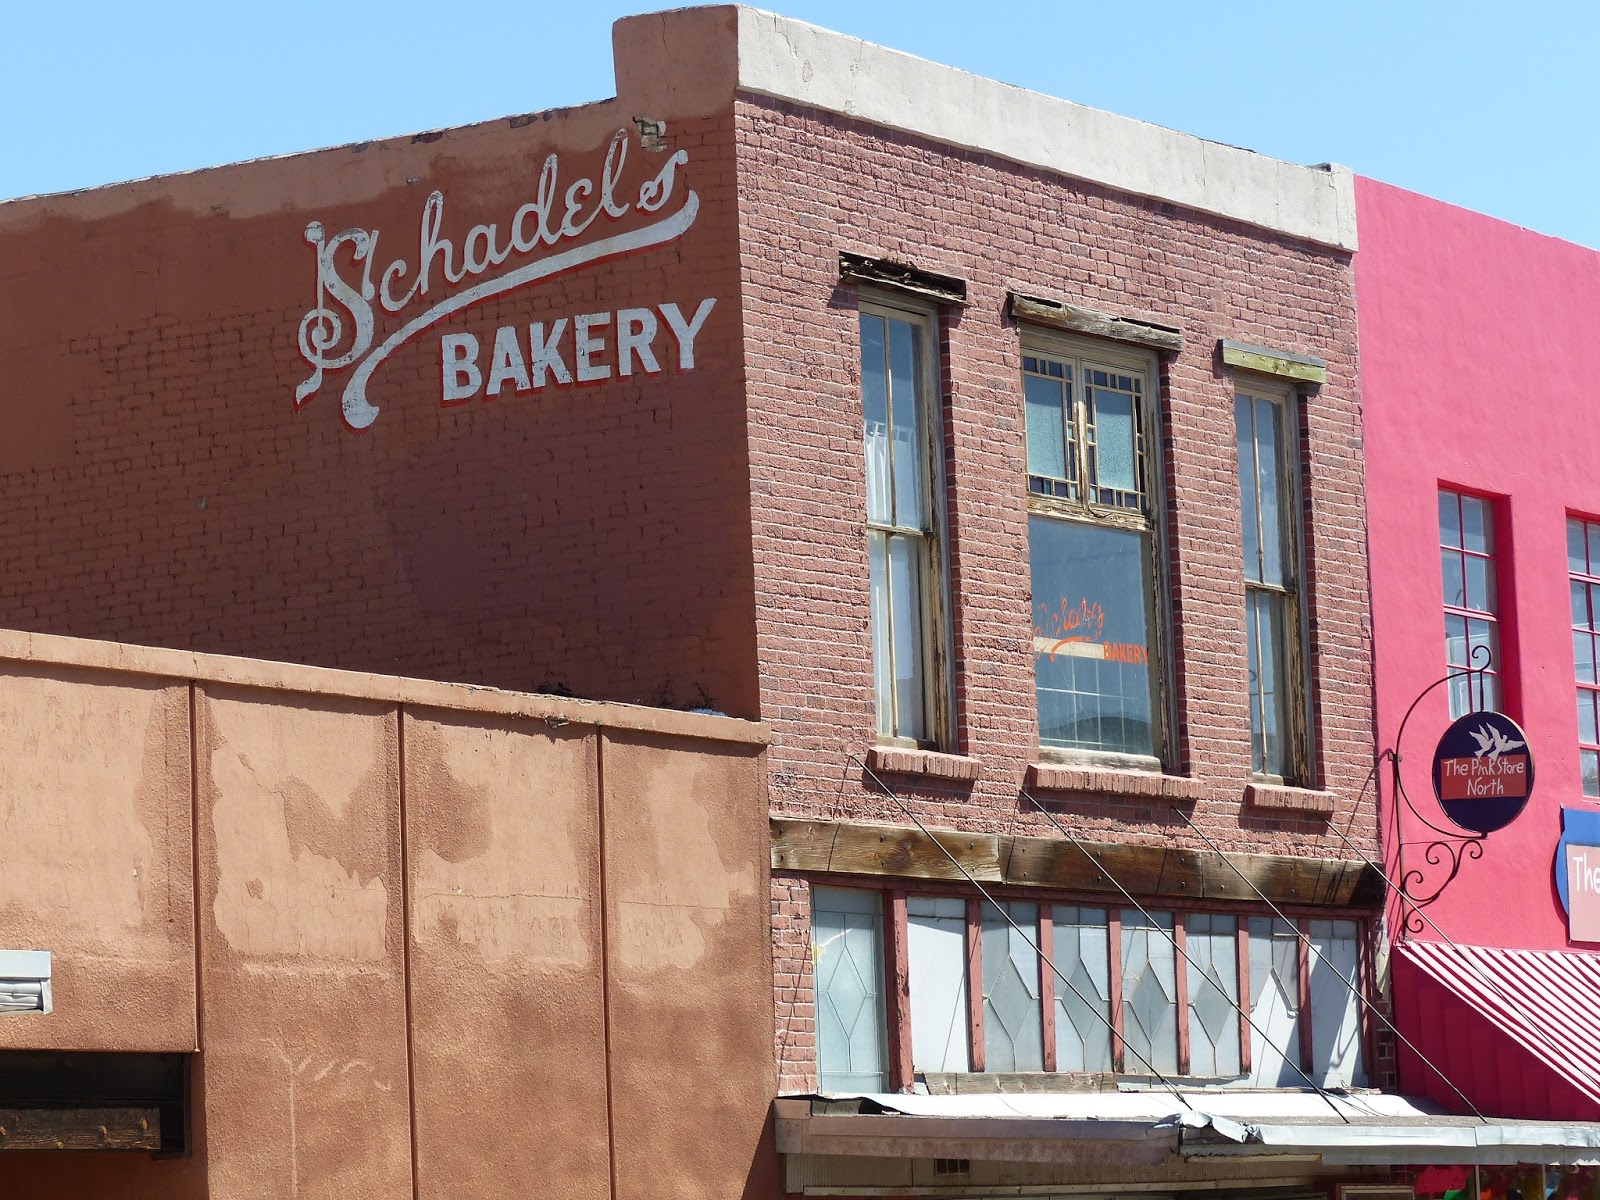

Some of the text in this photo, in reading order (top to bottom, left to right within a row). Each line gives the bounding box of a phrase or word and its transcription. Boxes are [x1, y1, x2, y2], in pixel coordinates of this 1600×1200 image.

[441, 298, 718, 402] BAKERY
[1103, 641, 1149, 665] BAKERY
[1443, 757, 1525, 777] The Pink Store
[1466, 776, 1504, 796] North
[1572, 851, 1600, 894] The
